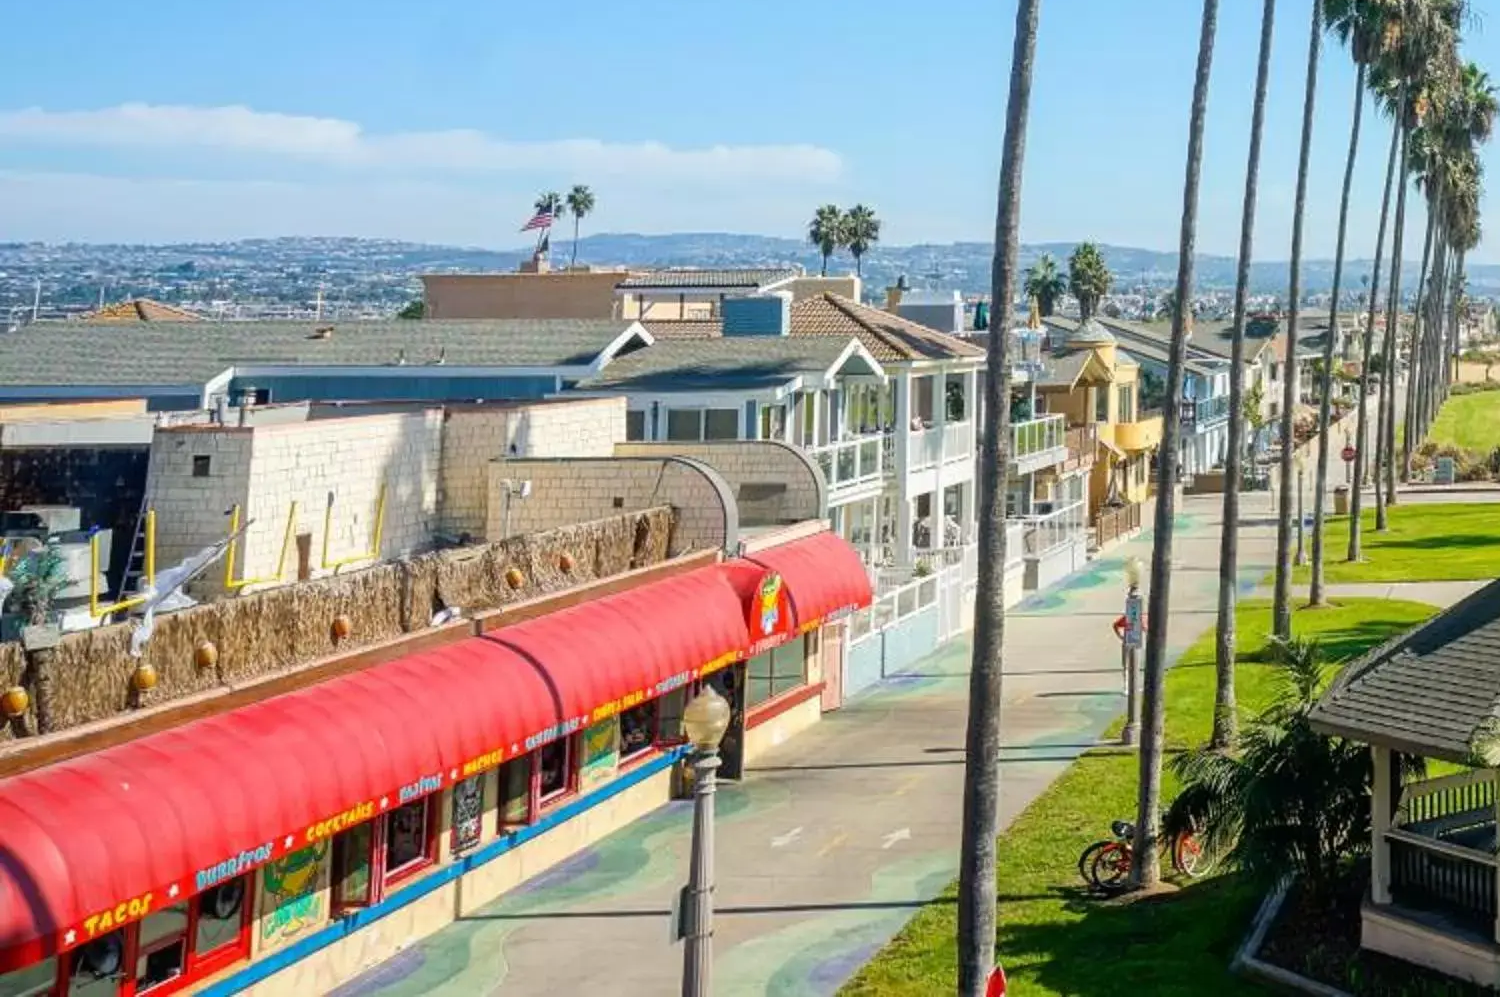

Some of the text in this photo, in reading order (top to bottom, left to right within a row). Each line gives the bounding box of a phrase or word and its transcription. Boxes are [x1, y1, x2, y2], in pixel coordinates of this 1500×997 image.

[84, 893, 153, 937] TACOS
[196, 842, 274, 890] BURRITOS
[306, 801, 375, 842] COCKTAILS
[464, 748, 504, 776] NACHOS
